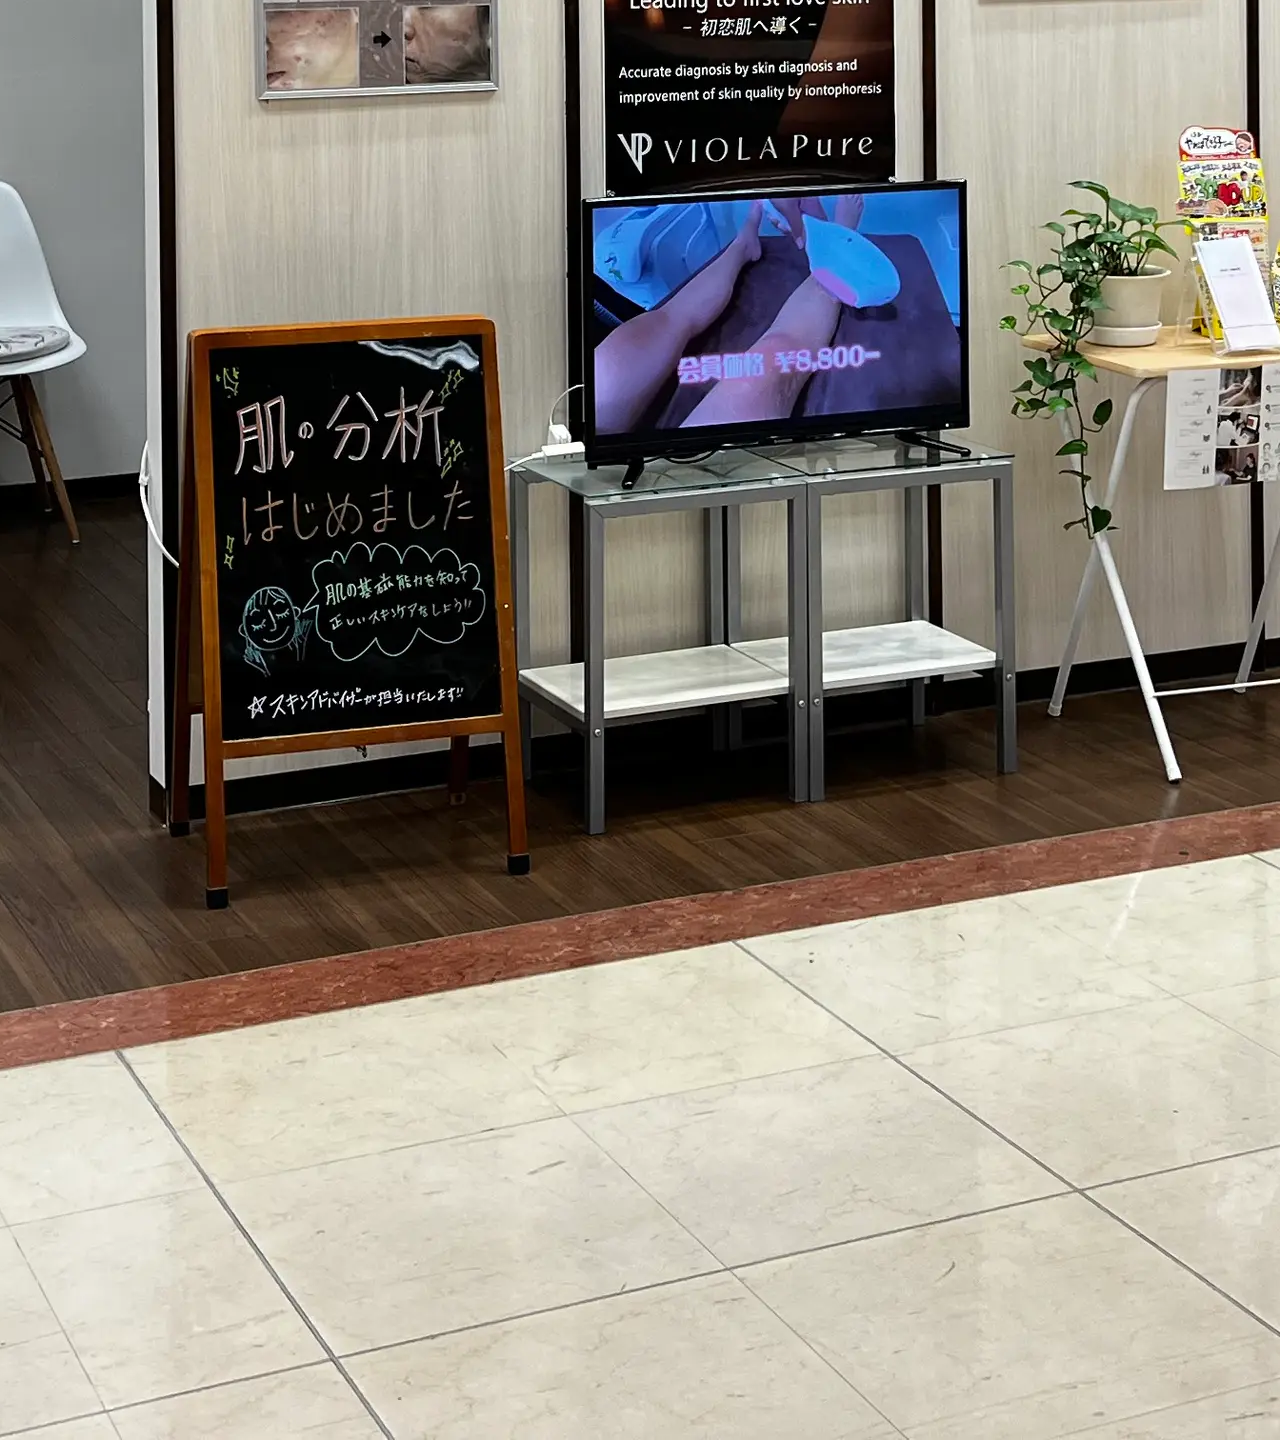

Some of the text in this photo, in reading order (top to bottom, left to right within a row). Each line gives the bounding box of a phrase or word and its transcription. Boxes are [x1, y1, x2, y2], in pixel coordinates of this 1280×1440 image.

[700, 17, 802, 37] 初恋肌へ導く
[619, 59, 858, 79] Accurate diagnosis by skin diagnosis and
[619, 82, 882, 106] improvement of skin quality by iontophoresis
[664, 135, 778, 164] VIOLA
[792, 134, 873, 158] Pure
[678, 352, 765, 384] 会員価格
[234, 386, 445, 475] 肌の分析
[242, 480, 474, 545] はじめました
